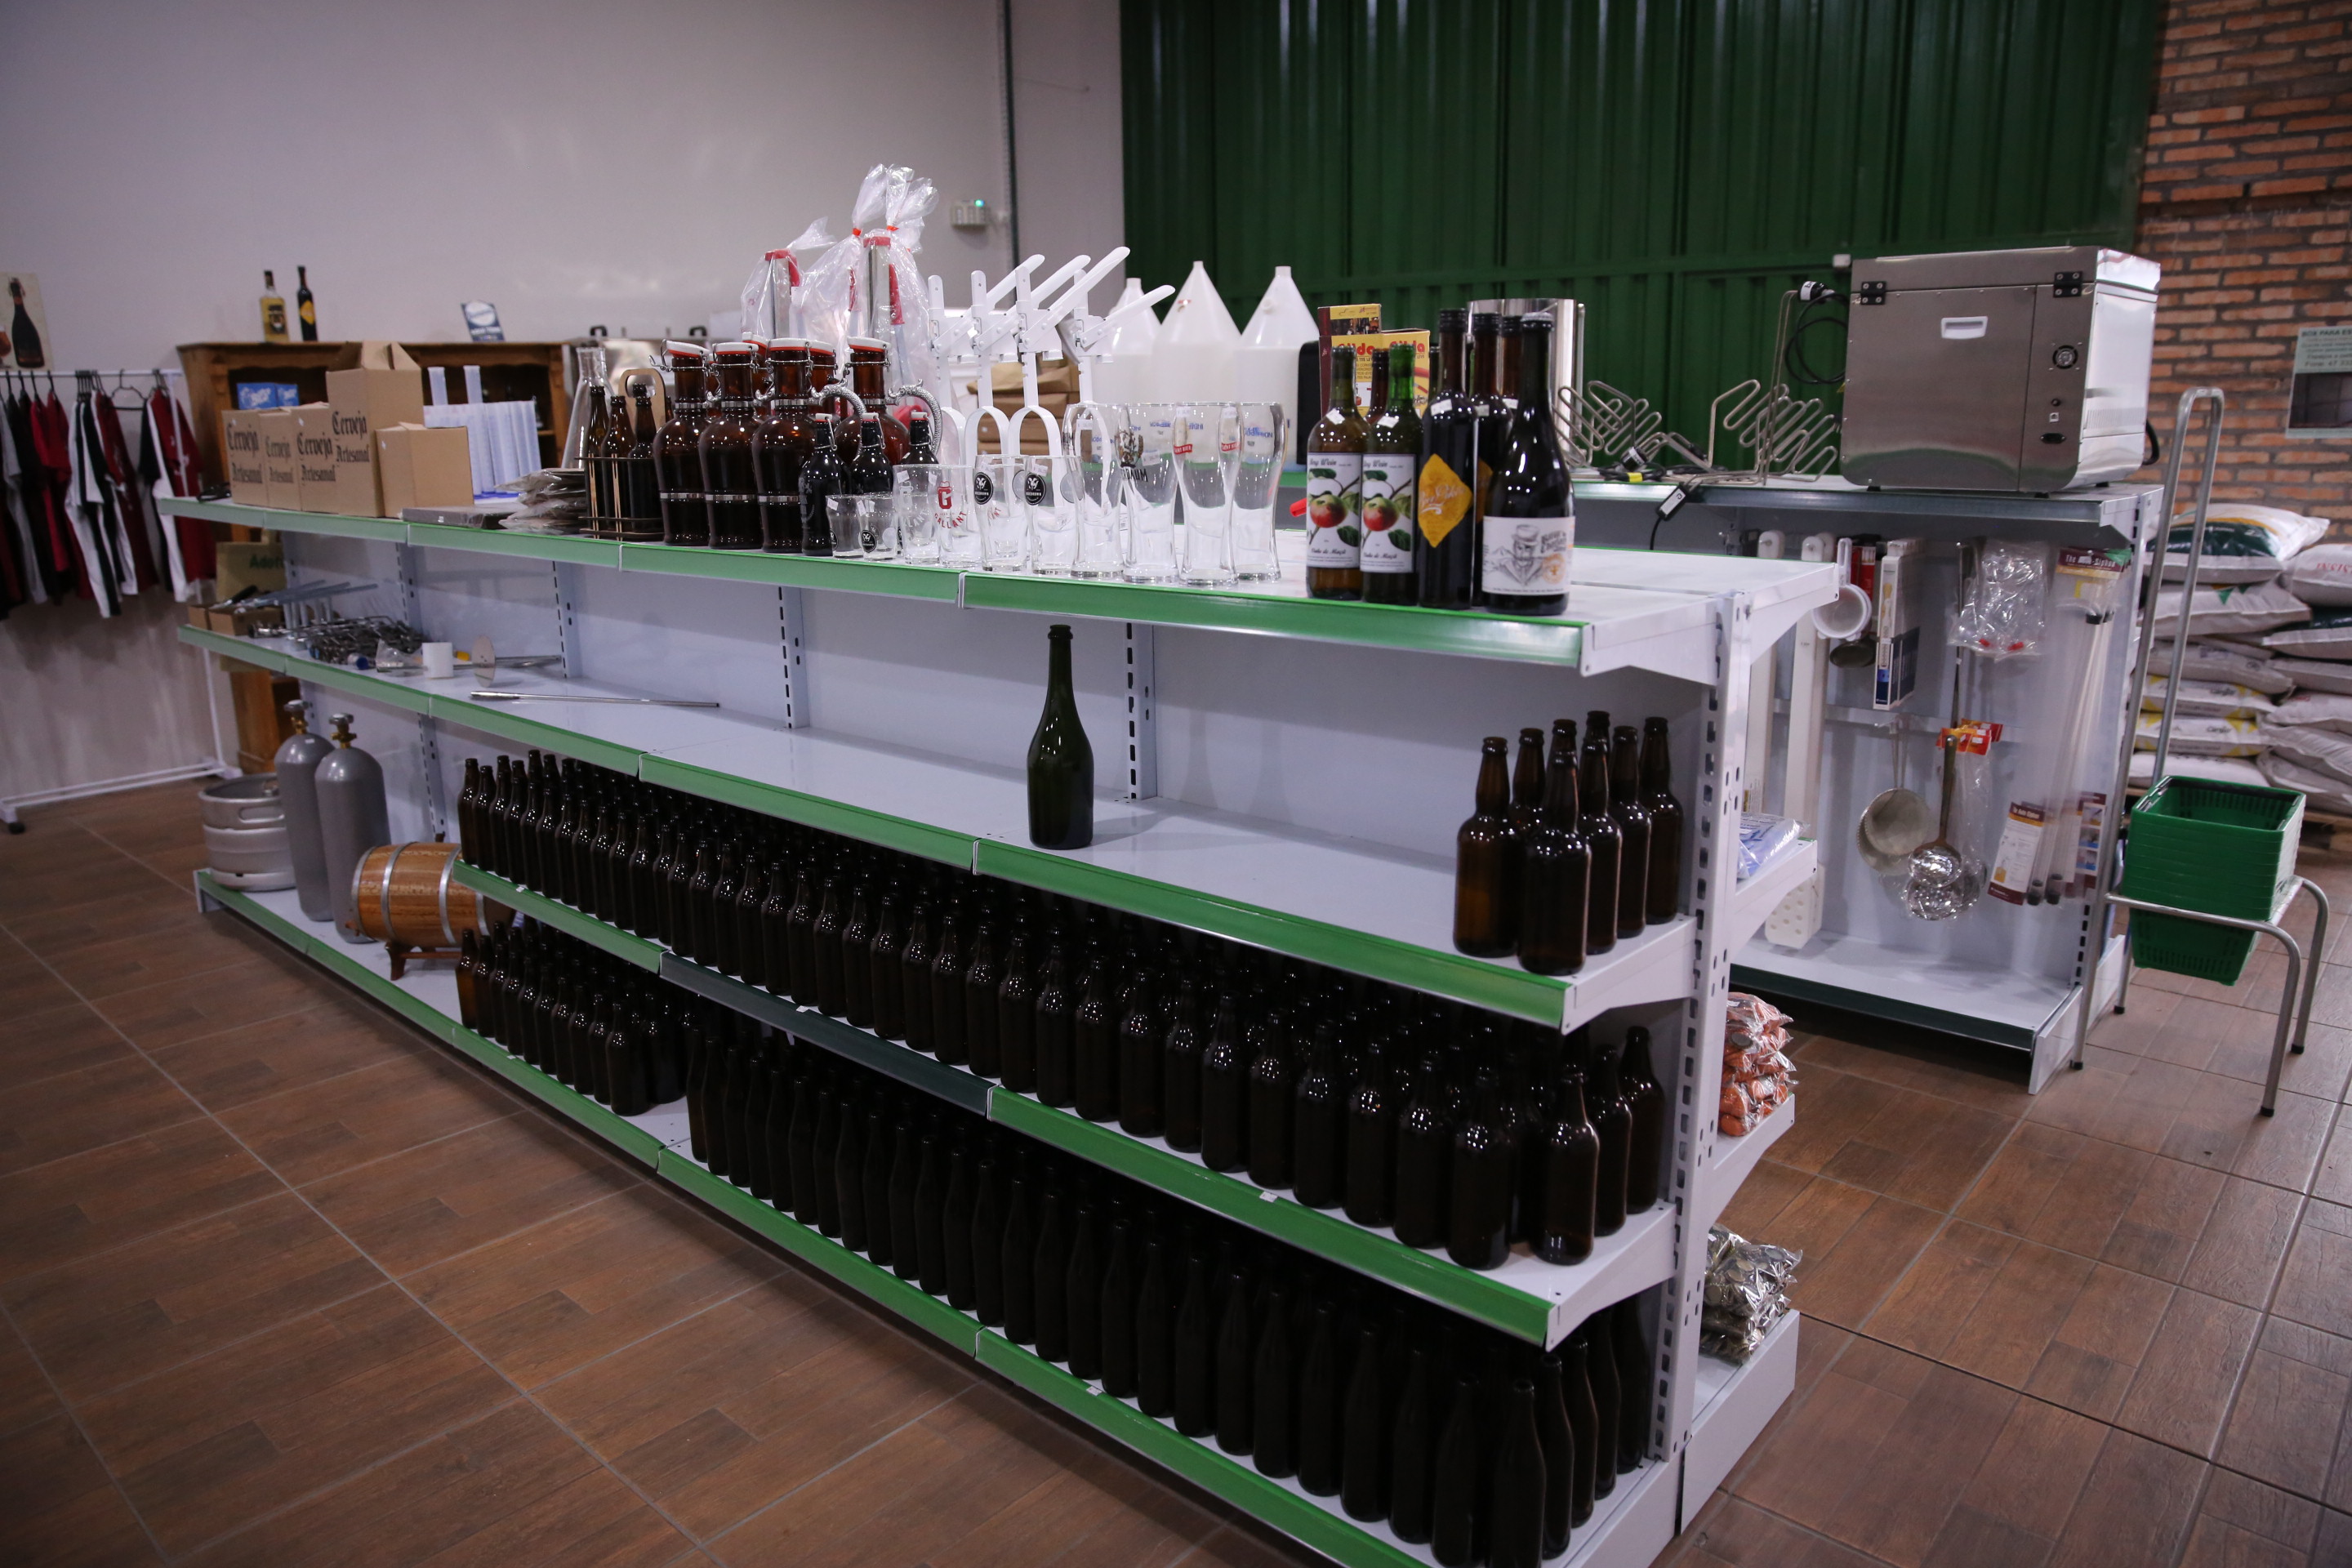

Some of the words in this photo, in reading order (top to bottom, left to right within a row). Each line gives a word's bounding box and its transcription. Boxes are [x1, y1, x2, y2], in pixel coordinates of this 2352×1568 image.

[332, 410, 367, 439] Cerveja
[296, 432, 333, 458] Cerveja
[336, 444, 369, 463] Artesanal
[934, 510, 967, 529] GALLANT
